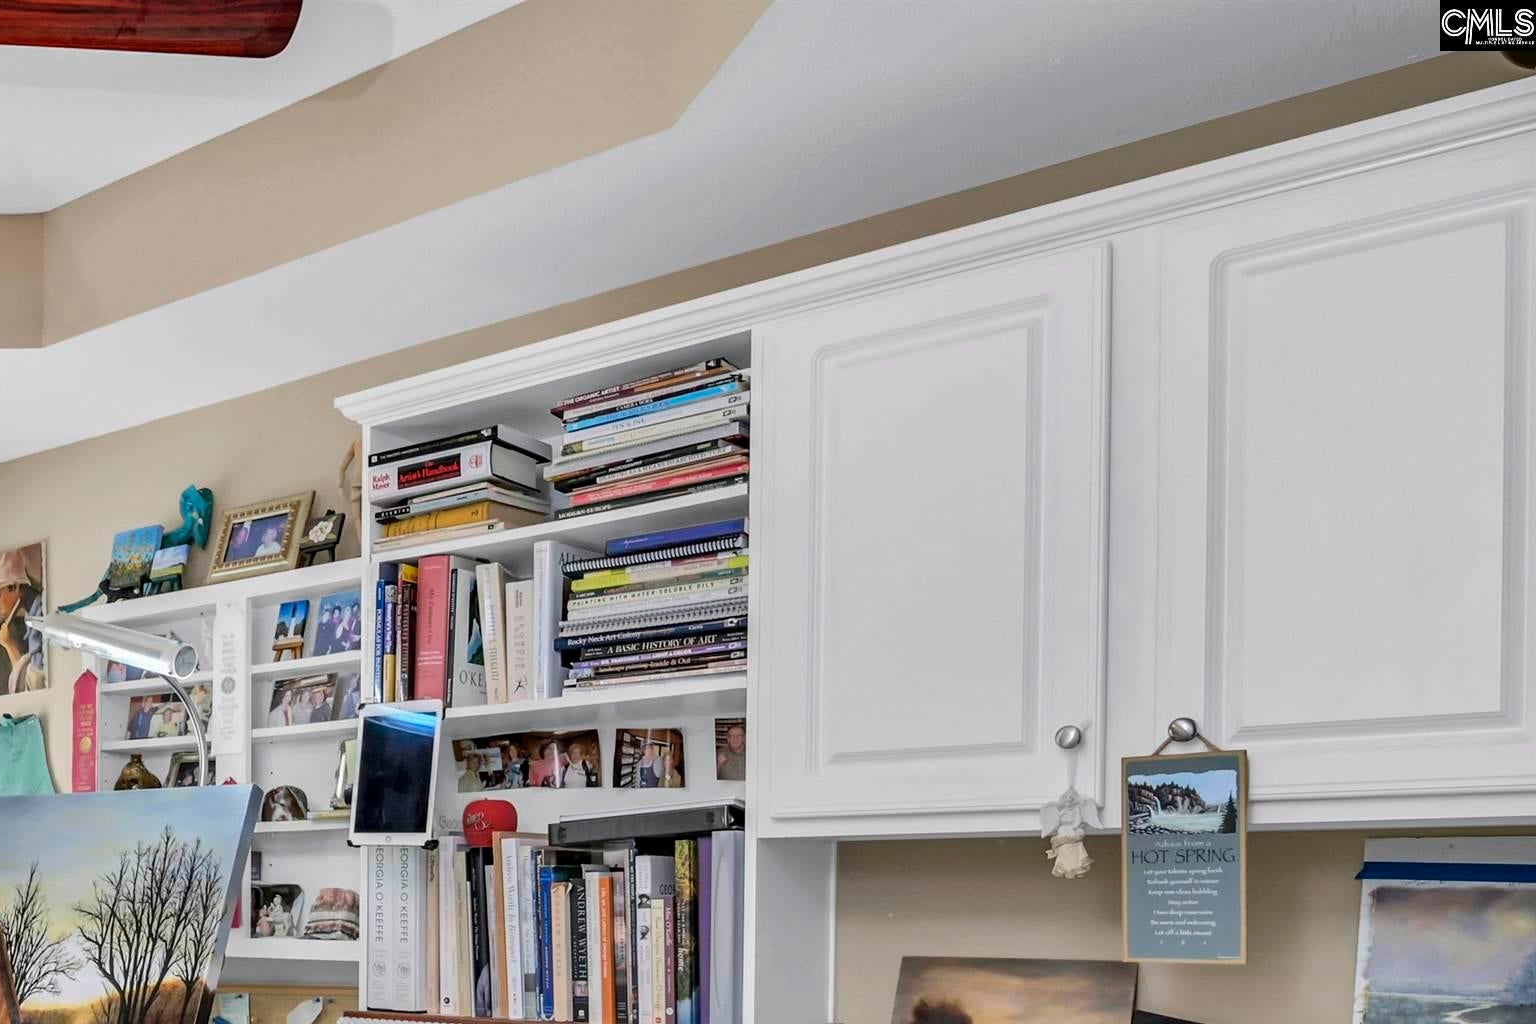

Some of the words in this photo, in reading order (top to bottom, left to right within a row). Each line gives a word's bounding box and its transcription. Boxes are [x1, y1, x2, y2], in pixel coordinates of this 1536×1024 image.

[574, 390, 602, 402] ORGANIC
[600, 385, 621, 396] ARTIST
[421, 461, 458, 478] Handbook
[567, 637, 586, 647] Rocky
[606, 646, 614, 655] A
[614, 643, 640, 654] BASIC
[641, 637, 679, 651] HISTORY
[681, 635, 697, 645] OF
[697, 633, 718, 644] ART
[459, 670, 485, 687] O'KE
[375, 845, 384, 889] EORGIA
[400, 847, 409, 889] EORGIA
[1131, 849, 1169, 865] HOT
[1175, 847, 1236, 864] SPRING
[375, 892, 384, 943] O'KEEFFE
[400, 892, 409, 944] O'KEEFFE
[575, 884, 587, 934] ANDREW
[577, 937, 588, 979] WYETH
[677, 947, 689, 972] home
